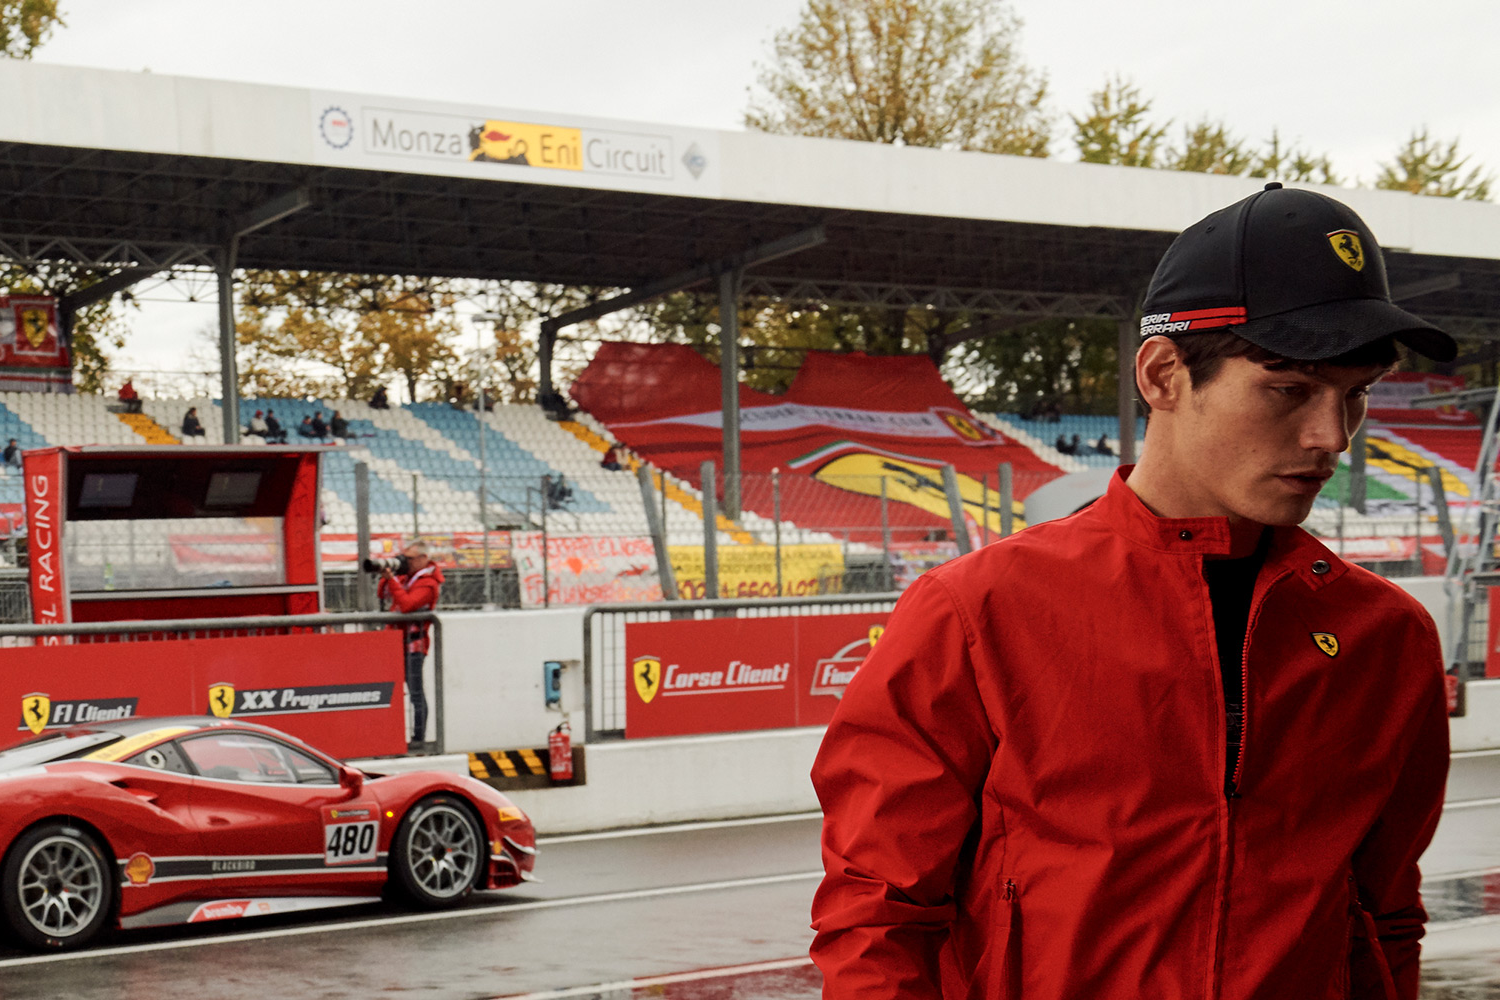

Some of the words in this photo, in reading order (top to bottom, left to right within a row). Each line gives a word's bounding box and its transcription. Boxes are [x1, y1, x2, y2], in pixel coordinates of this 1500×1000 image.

[372, 118, 462, 155] Monza
[540, 133, 579, 166] Eni
[586, 138, 666, 175] Circuit
[1141, 313, 1171, 327] ERIA
[32, 474, 55, 592] RACING
[663, 664, 724, 689] Corse
[725, 660, 790, 686] Clienti
[821, 664, 861, 686] Final
[239, 689, 277, 710] XX
[280, 688, 382, 710] Programmes
[75, 702, 133, 722] Clienti
[327, 823, 374, 857] 480
[212, 860, 256, 871] BLACKBIRD
[203, 903, 243, 919] brembo
